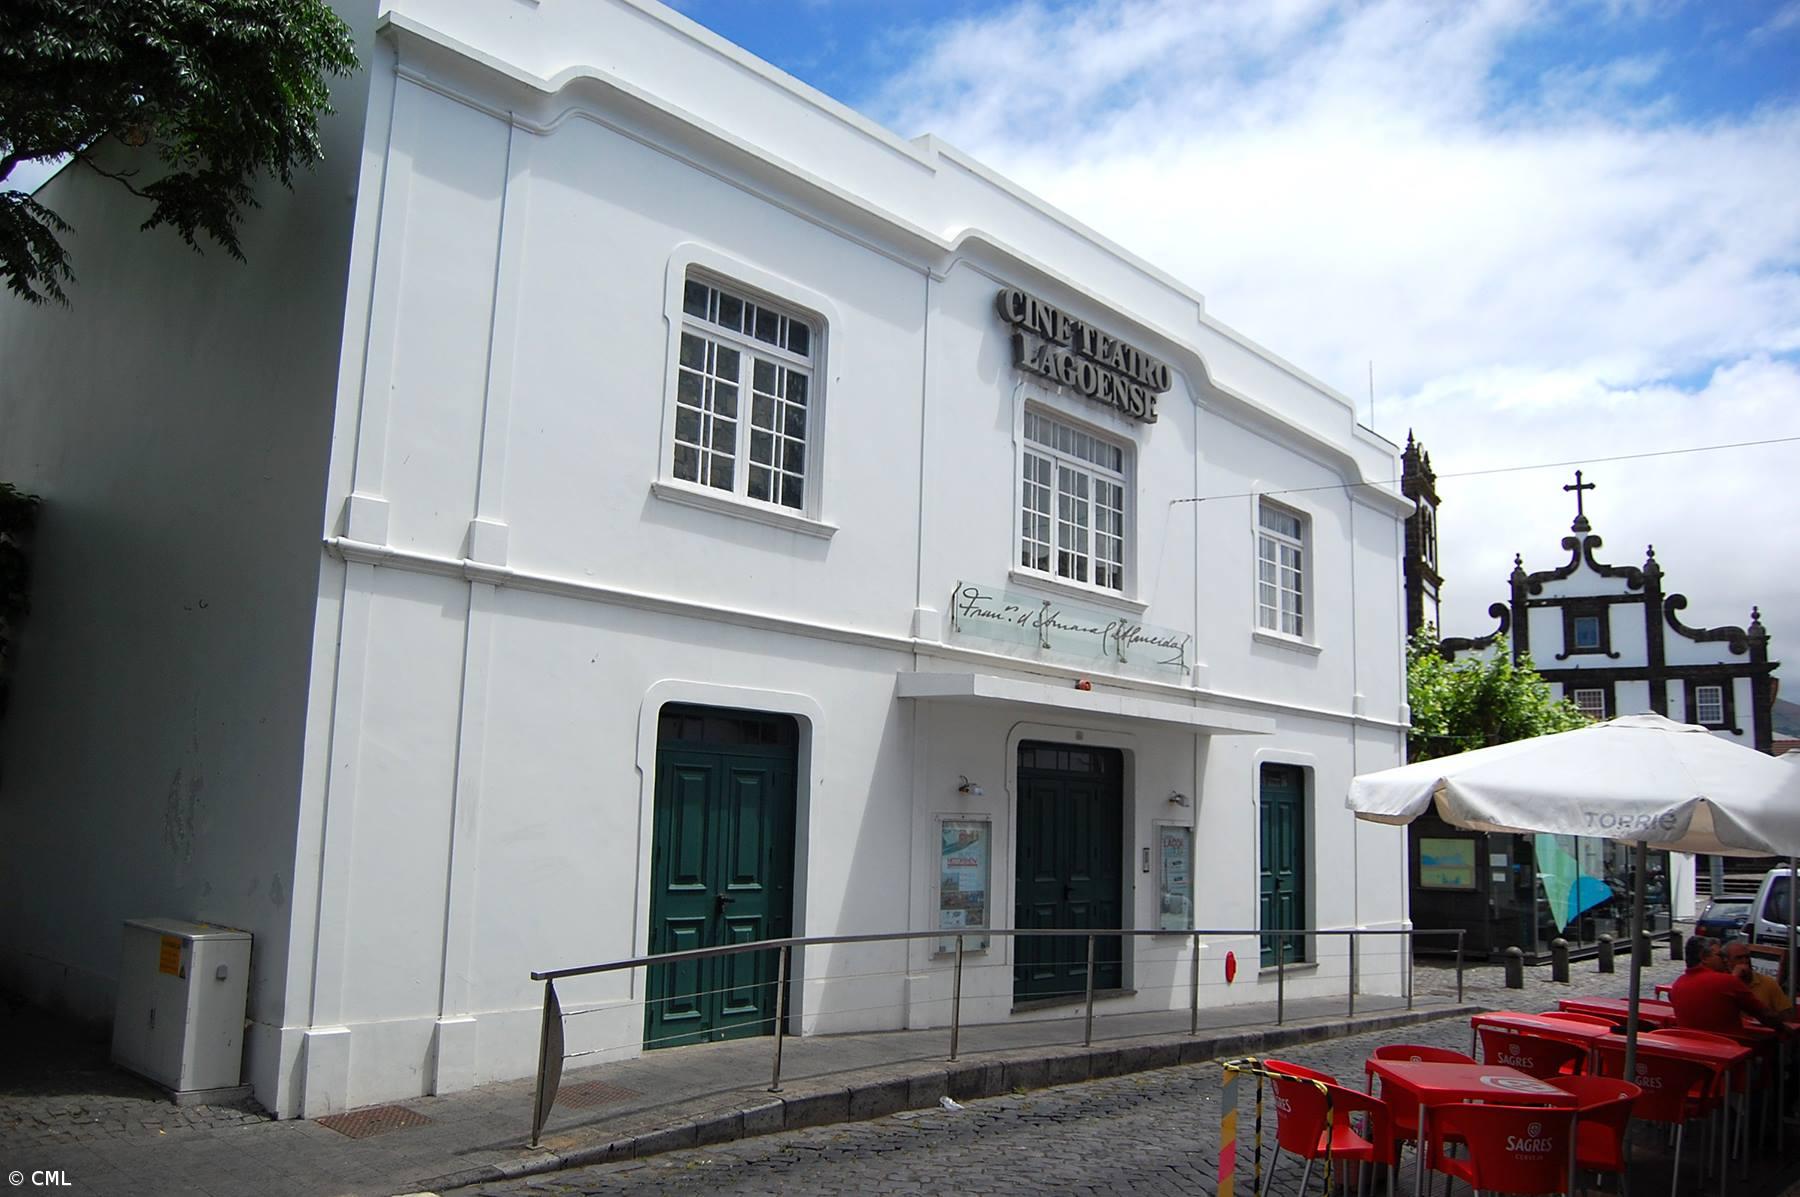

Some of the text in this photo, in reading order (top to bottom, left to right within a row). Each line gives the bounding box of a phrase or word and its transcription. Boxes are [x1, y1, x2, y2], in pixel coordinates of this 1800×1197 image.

[996, 287, 1173, 394] CINE TEATRO
[1012, 332, 1159, 424] LAGOENSE
[1497, 1051, 1534, 1069] SAGRES
[1635, 1075, 1663, 1089] GRES
[1505, 1135, 1553, 1152] SAGRES
